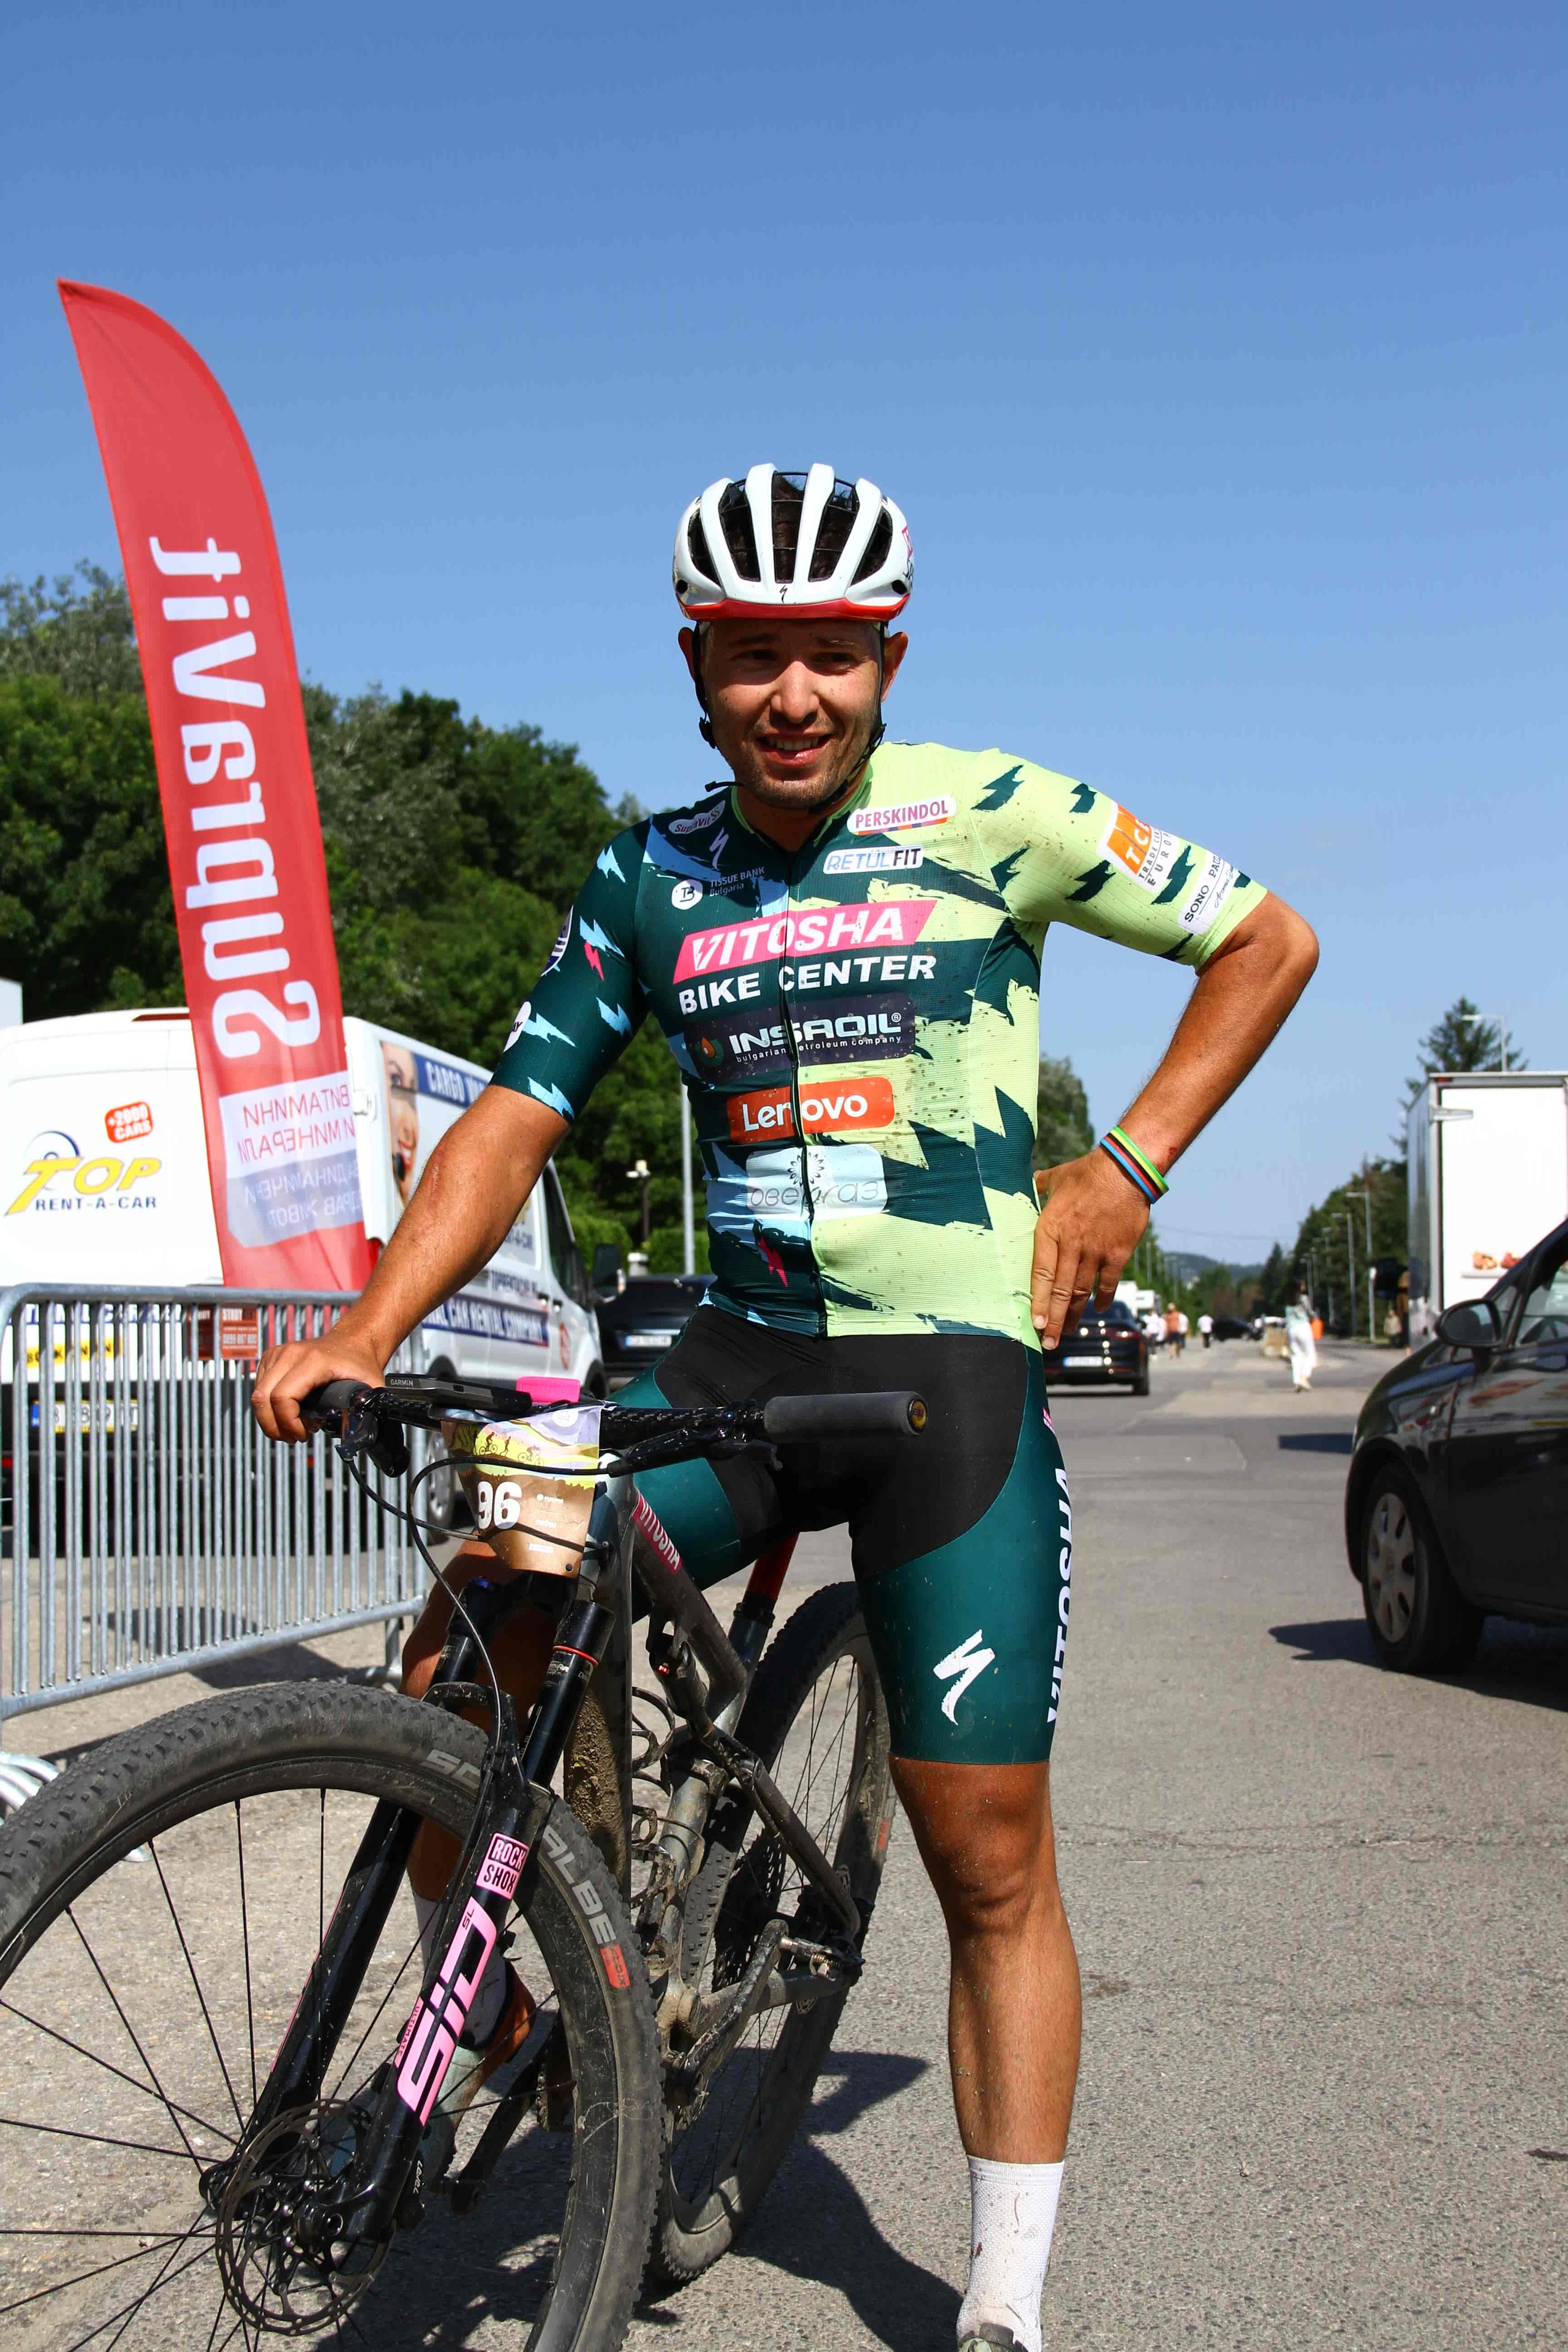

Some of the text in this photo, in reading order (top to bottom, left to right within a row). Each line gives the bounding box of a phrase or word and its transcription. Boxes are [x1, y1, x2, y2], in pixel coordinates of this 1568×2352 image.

[855, 799, 949, 829] PERSKINDOL
[710, 865, 766, 888] TISSUE BANK
[1139, 846, 1158, 879] TRADE
[709, 882, 745, 897] Bulgaria
[1185, 885, 1210, 922] SONO
[692, 907, 904, 971] VITOSHA
[679, 954, 937, 1016] BIKE CENTER
[736, 1035, 902, 1063] bulgarian etroleum company
[742, 1094, 869, 1133] Lenovo
[114, 1120, 153, 1141] CARS
[4, 1156, 162, 1217] TOP
[35, 1196, 157, 1212] RENT-A-CAR
[390, 1379, 414, 1387] GARMIN
[477, 1480, 522, 1529] 96
[491, 1842, 527, 1871] ROCK
[483, 1863, 516, 1894] SHOX
[461, 1907, 475, 1931] SL
